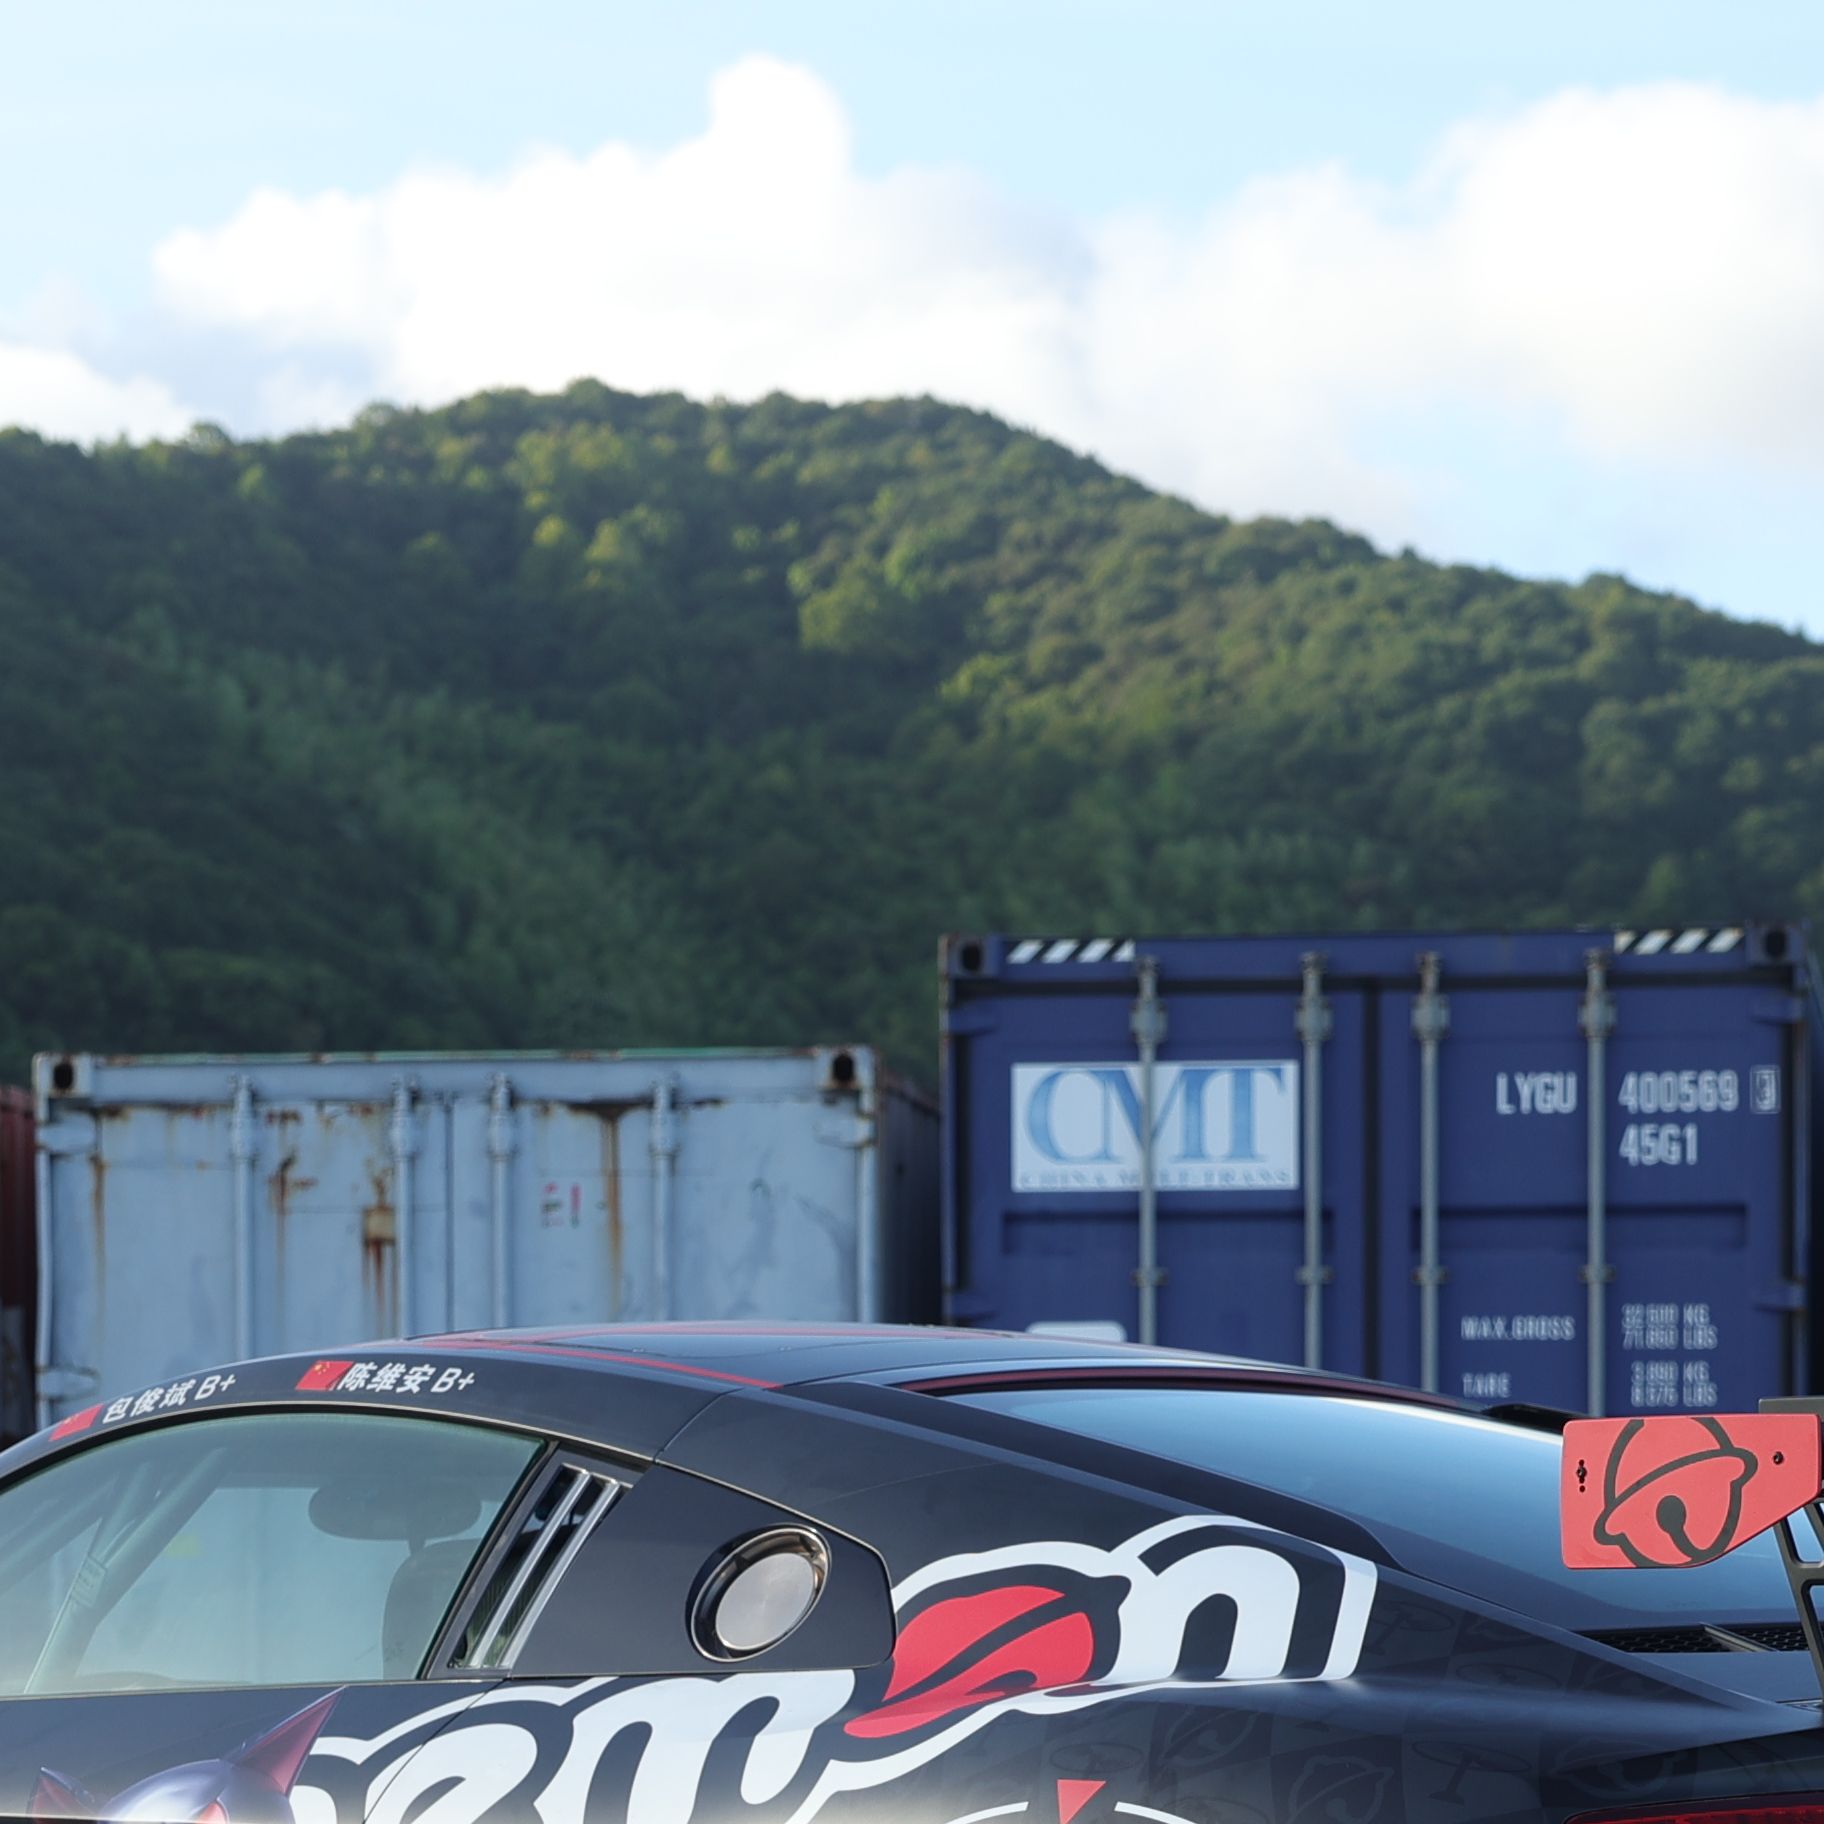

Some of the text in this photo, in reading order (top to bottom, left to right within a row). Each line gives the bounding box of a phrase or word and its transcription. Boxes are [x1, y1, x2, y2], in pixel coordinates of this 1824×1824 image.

[1496, 1072, 1577, 1114] LYGU
[1618, 1070, 1738, 1114] 400569
[1027, 1067, 1286, 1164] CMT
[1619, 1123, 1697, 1166] 45G1
[194, 1374, 237, 1400] B+
[338, 1363, 476, 1394] 陈维安 B+
[1462, 1372, 1511, 1398] TARE
